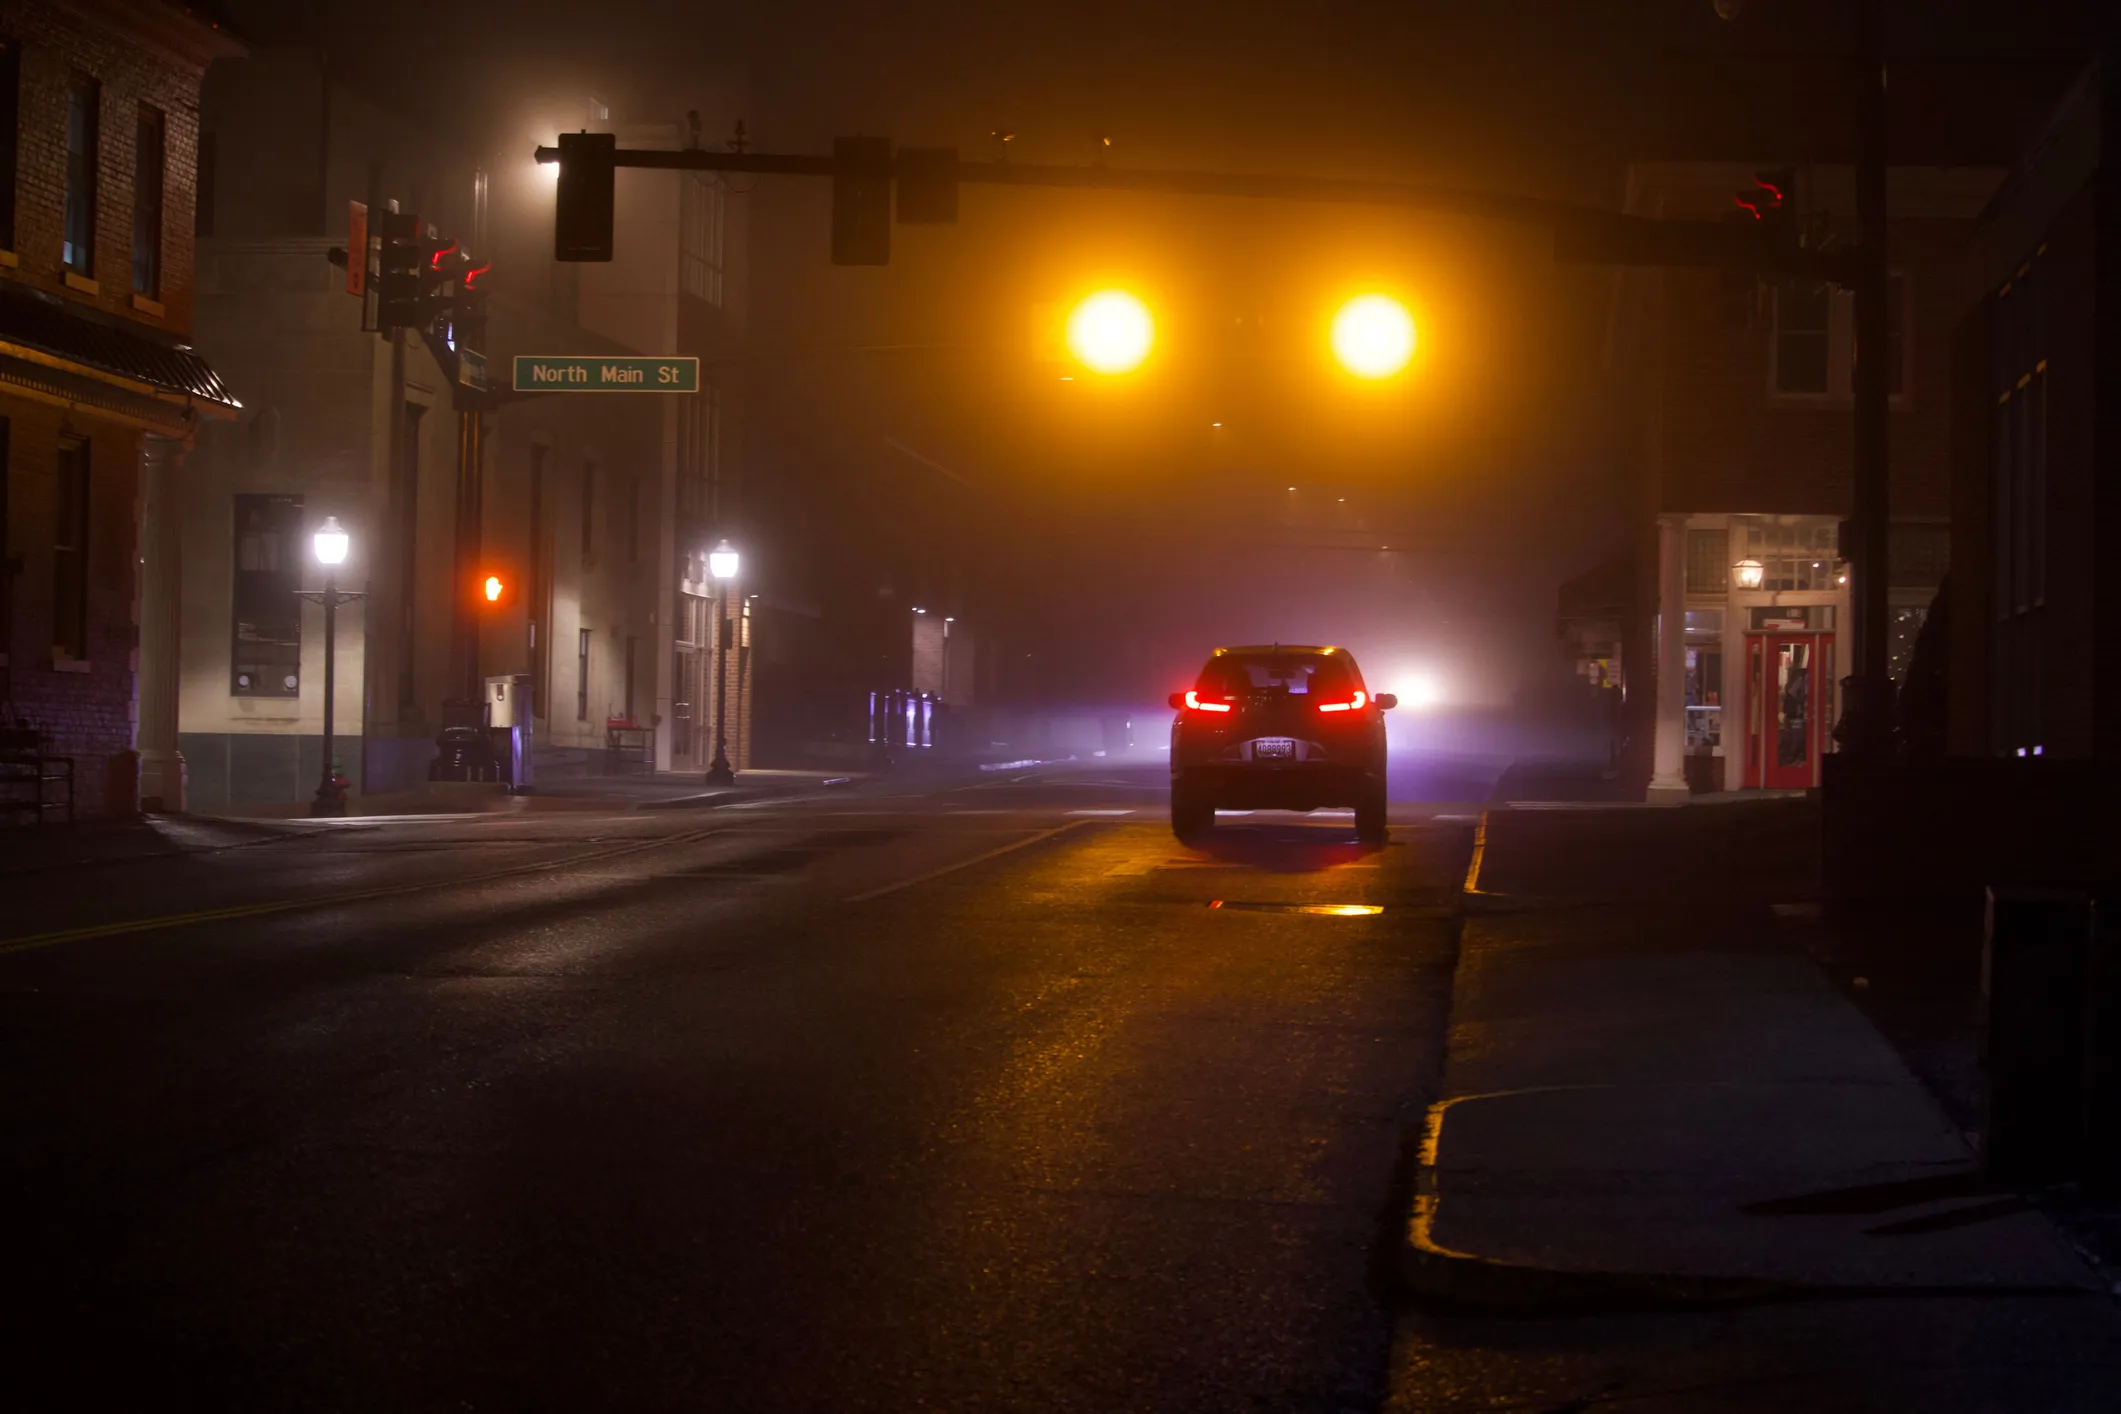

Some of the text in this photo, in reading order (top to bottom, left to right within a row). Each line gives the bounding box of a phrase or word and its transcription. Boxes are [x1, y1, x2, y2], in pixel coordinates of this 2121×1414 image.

[532, 364, 680, 384] North Main St
